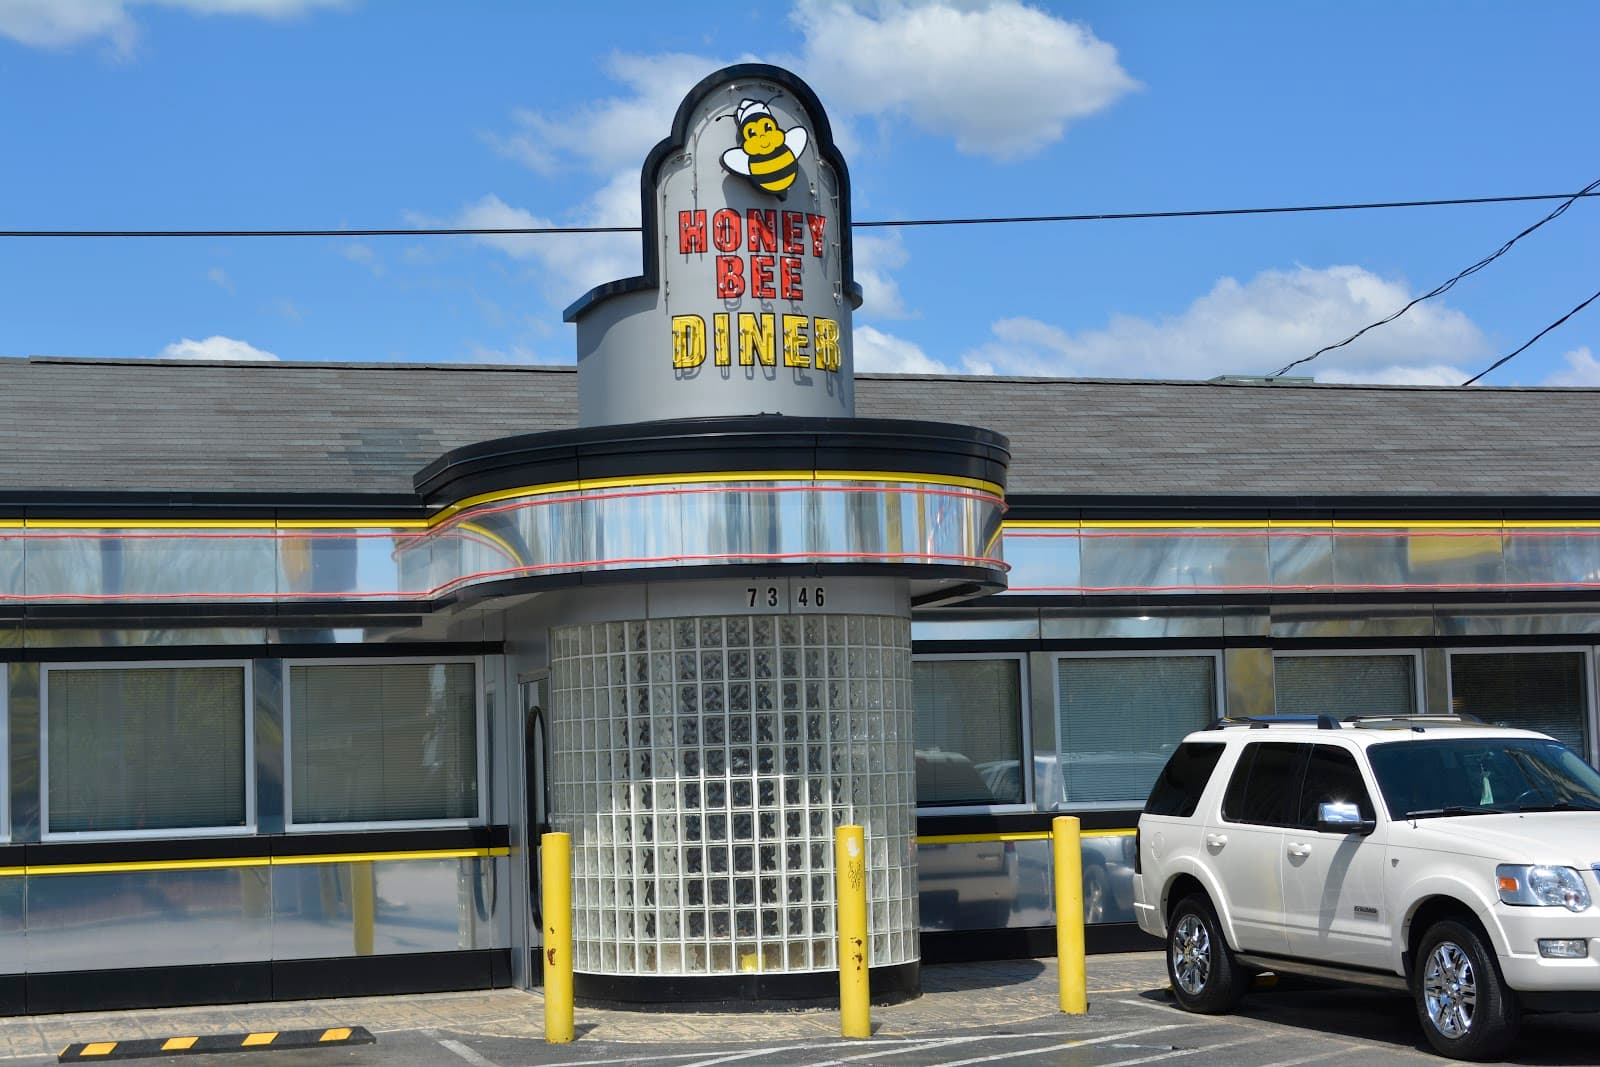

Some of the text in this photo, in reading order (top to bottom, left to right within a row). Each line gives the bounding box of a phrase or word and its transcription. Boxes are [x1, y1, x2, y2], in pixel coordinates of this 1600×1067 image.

[678, 208, 827, 257] HONEY
[716, 255, 803, 300] BEE
[672, 312, 841, 372] DINER
